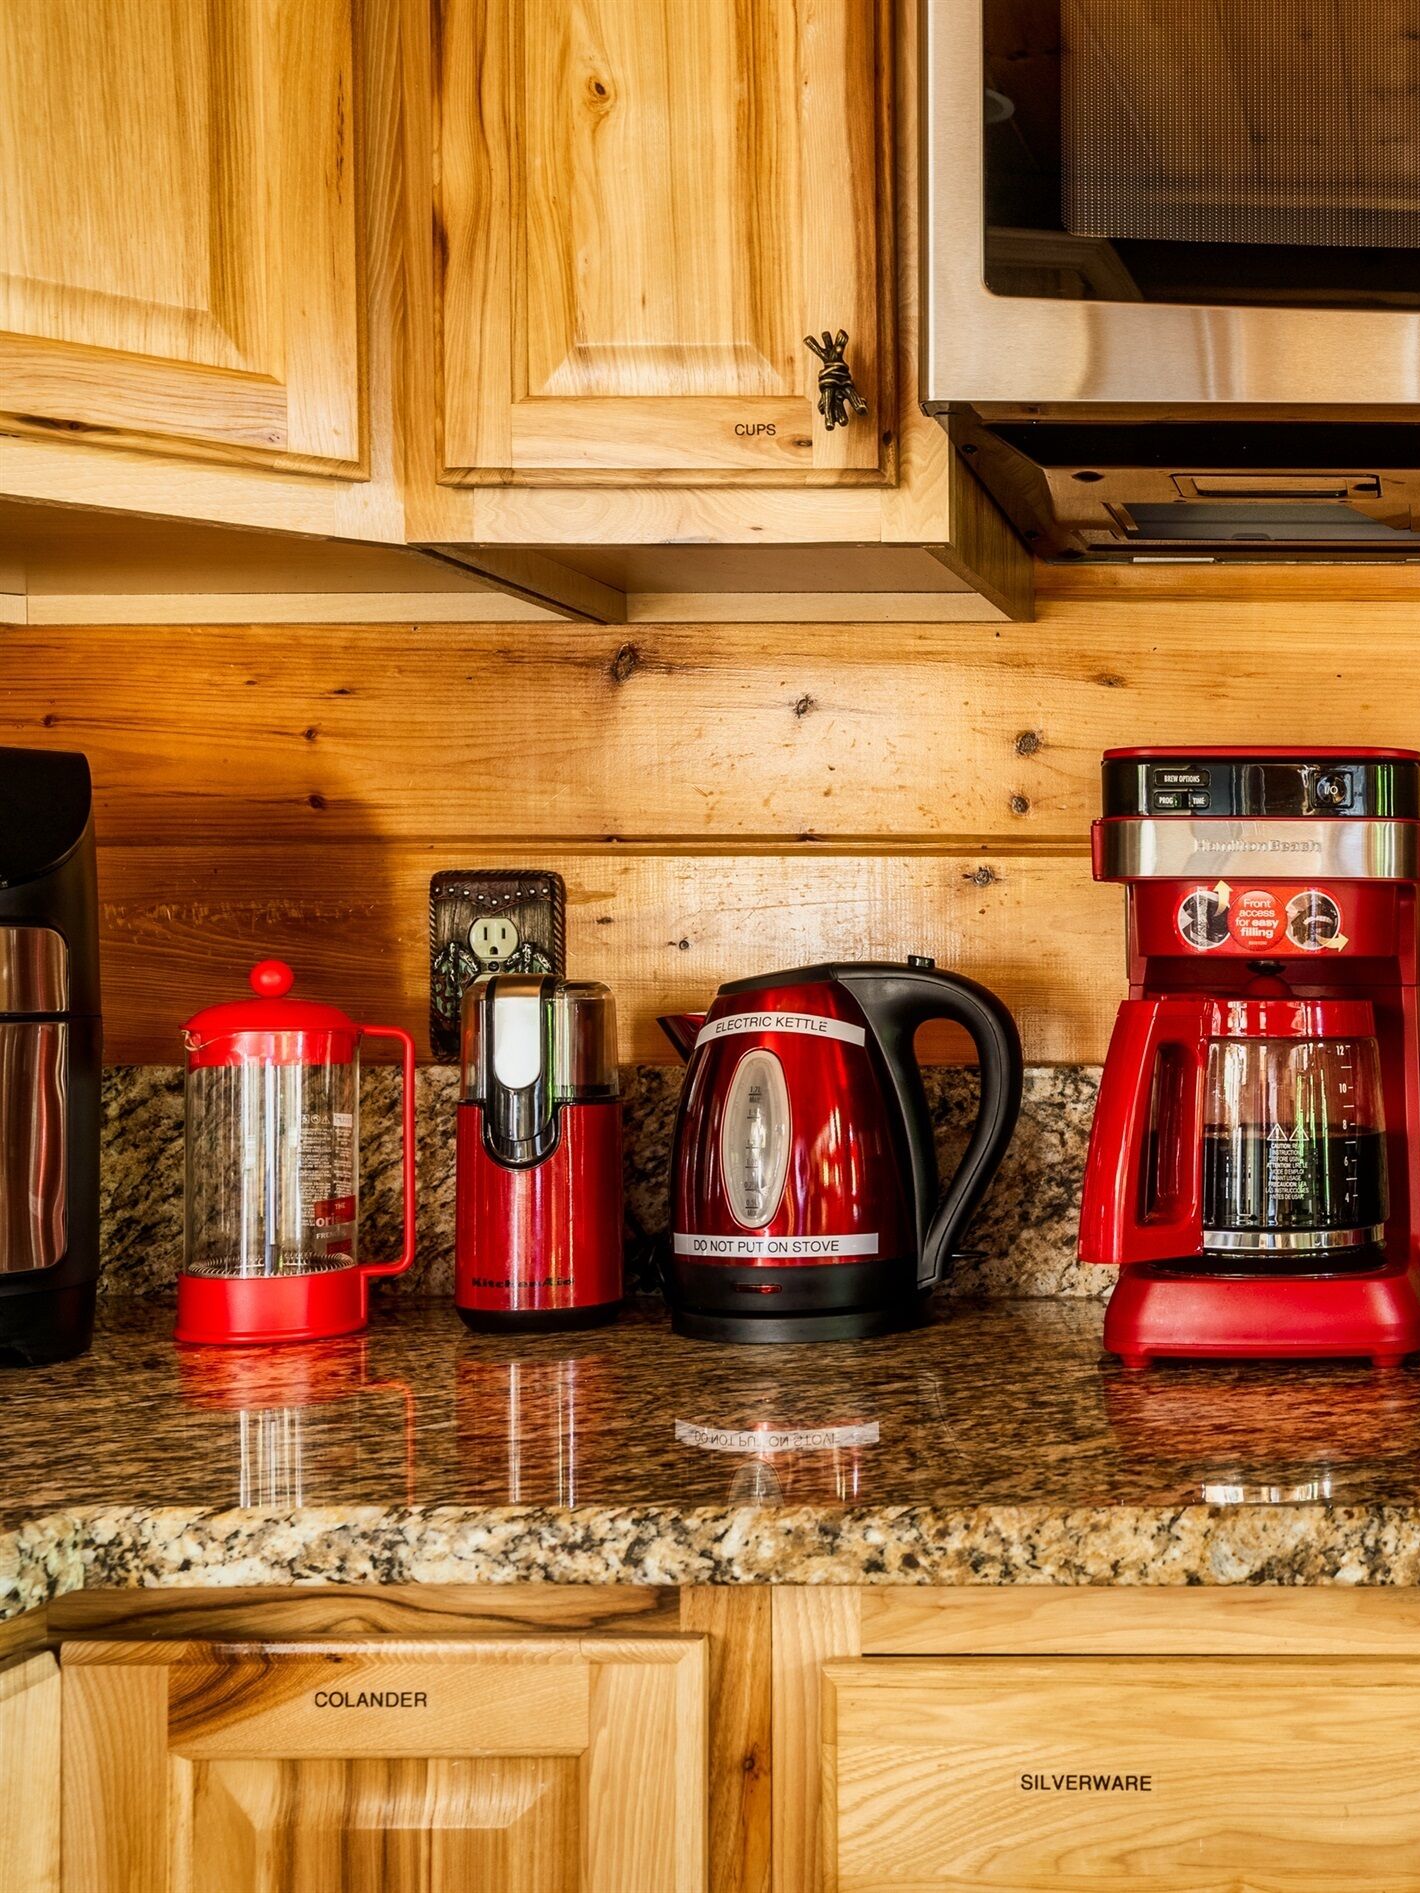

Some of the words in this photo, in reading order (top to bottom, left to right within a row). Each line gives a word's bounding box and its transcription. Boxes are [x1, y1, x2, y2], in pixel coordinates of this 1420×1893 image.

[735, 424, 776, 436] CUPS
[1164, 775, 1178, 783] BREW
[1179, 775, 1200, 783] OPTIONS
[1195, 839, 1268, 852] Hamilton
[1270, 839, 1321, 852] Beach
[1244, 899, 1272, 908] Front
[1235, 917, 1250, 926] for
[1251, 919, 1279, 928] easy
[1241, 927, 1274, 938] filling
[715, 1016, 772, 1033] ELECTRIC
[775, 1017, 828, 1032] KETTLE
[1336, 1046, 1344, 1055] 12
[1339, 1083, 1347, 1093] 10
[1342, 1119, 1348, 1129] 8
[1343, 1156, 1349, 1166] 6
[1344, 1193, 1350, 1203] 4
[693, 1239, 708, 1251] DO
[710, 1240, 734, 1252] NOT
[738, 1241, 764, 1253] PUT
[767, 1241, 788, 1253] ON
[792, 1240, 839, 1253] STOVE
[314, 1691, 427, 1708] COLANDER
[1020, 1774, 1152, 1791] SILVERWARE
